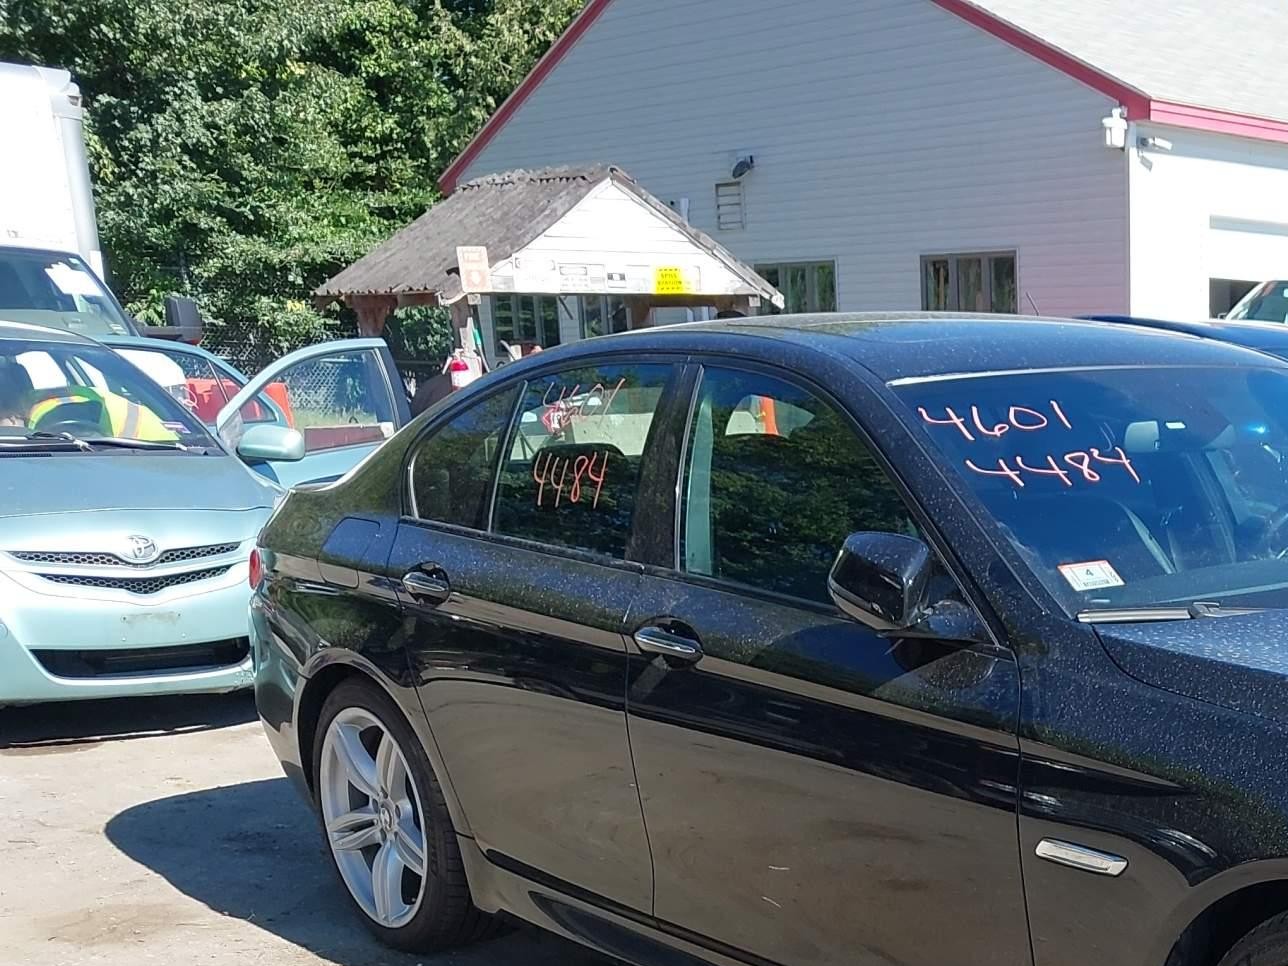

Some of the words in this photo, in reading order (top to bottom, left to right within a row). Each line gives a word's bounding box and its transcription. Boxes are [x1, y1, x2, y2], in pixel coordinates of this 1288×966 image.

[918, 400, 1072, 441] 4601
[533, 450, 609, 509] 4484
[966, 446, 1140, 487] 4484
